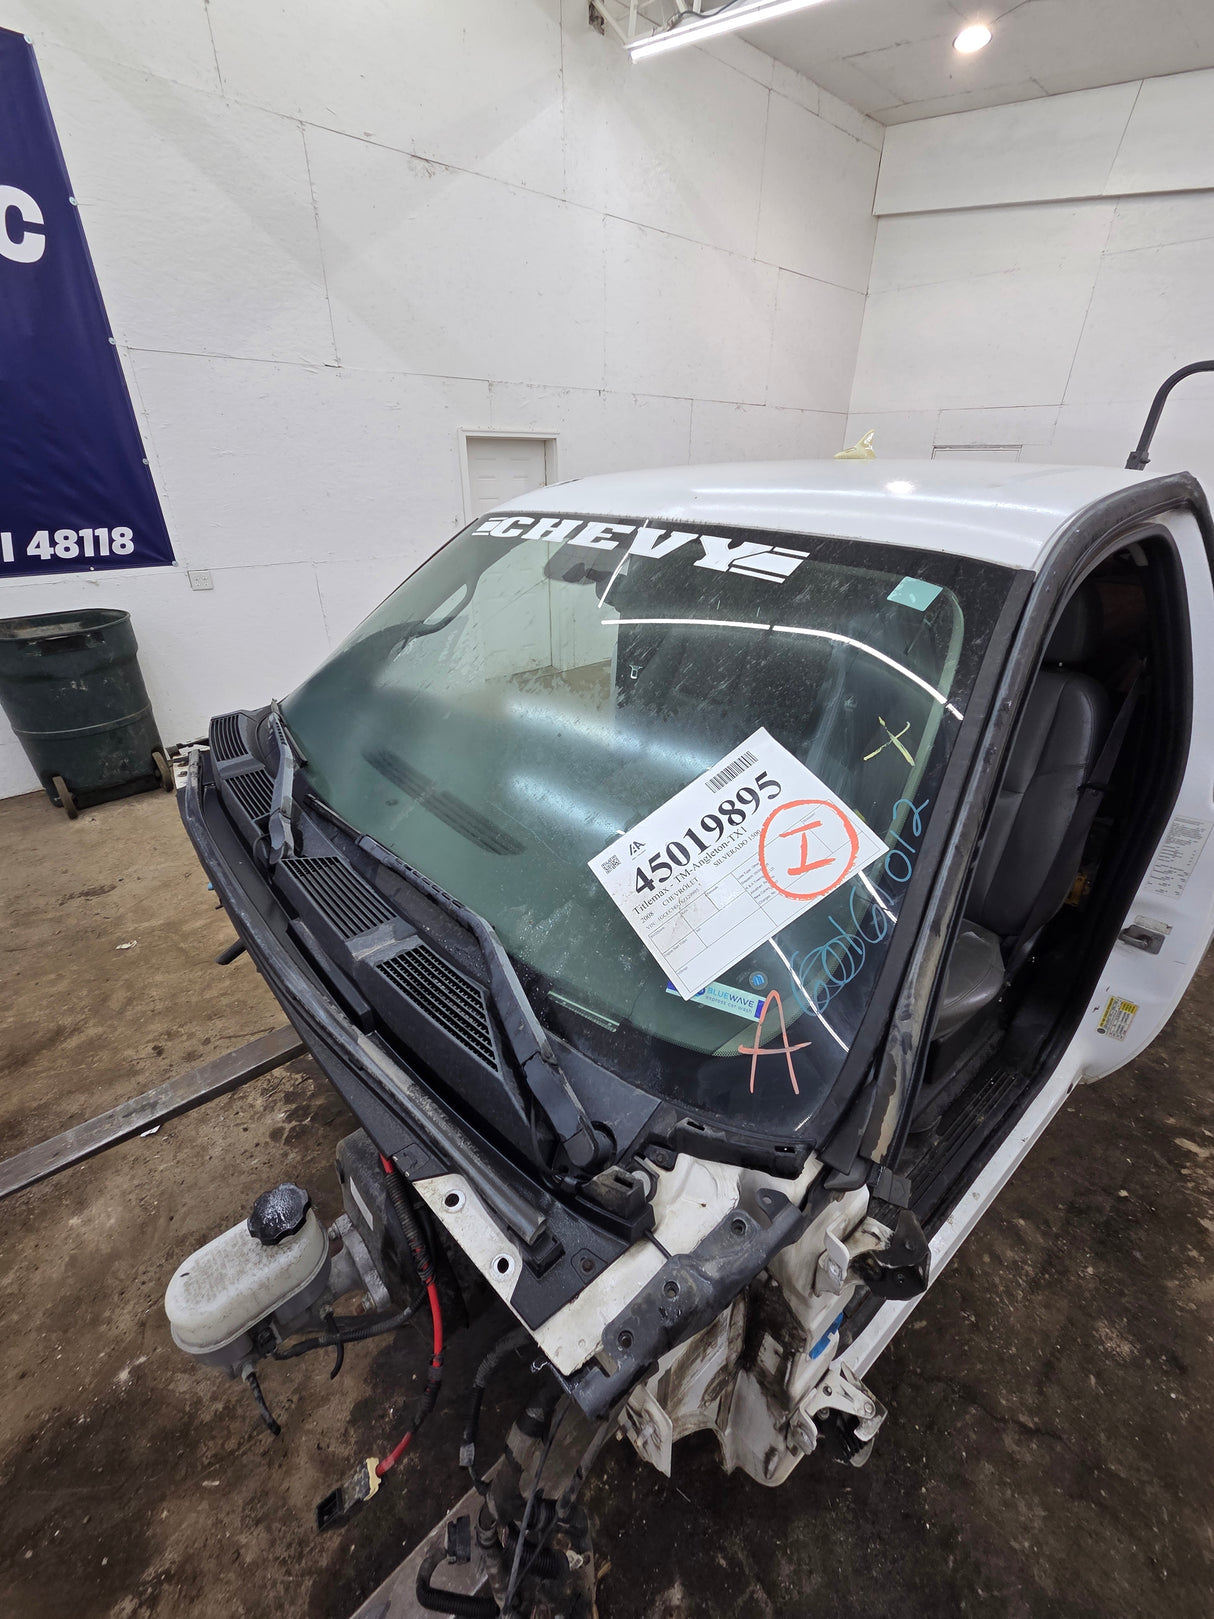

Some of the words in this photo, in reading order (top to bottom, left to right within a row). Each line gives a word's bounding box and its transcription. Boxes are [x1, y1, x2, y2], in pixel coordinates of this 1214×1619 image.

[26, 526, 135, 560] 48118
[480, 516, 798, 577] CHEVY
[636, 770, 781, 894] 45019895
[632, 886, 669, 914] Titlemax
[662, 876, 698, 906] CHEVROLET
[713, 838, 749, 867] SILVERADO
[707, 986, 755, 1009] BLUEWAVE
[738, 989, 813, 1095] A
